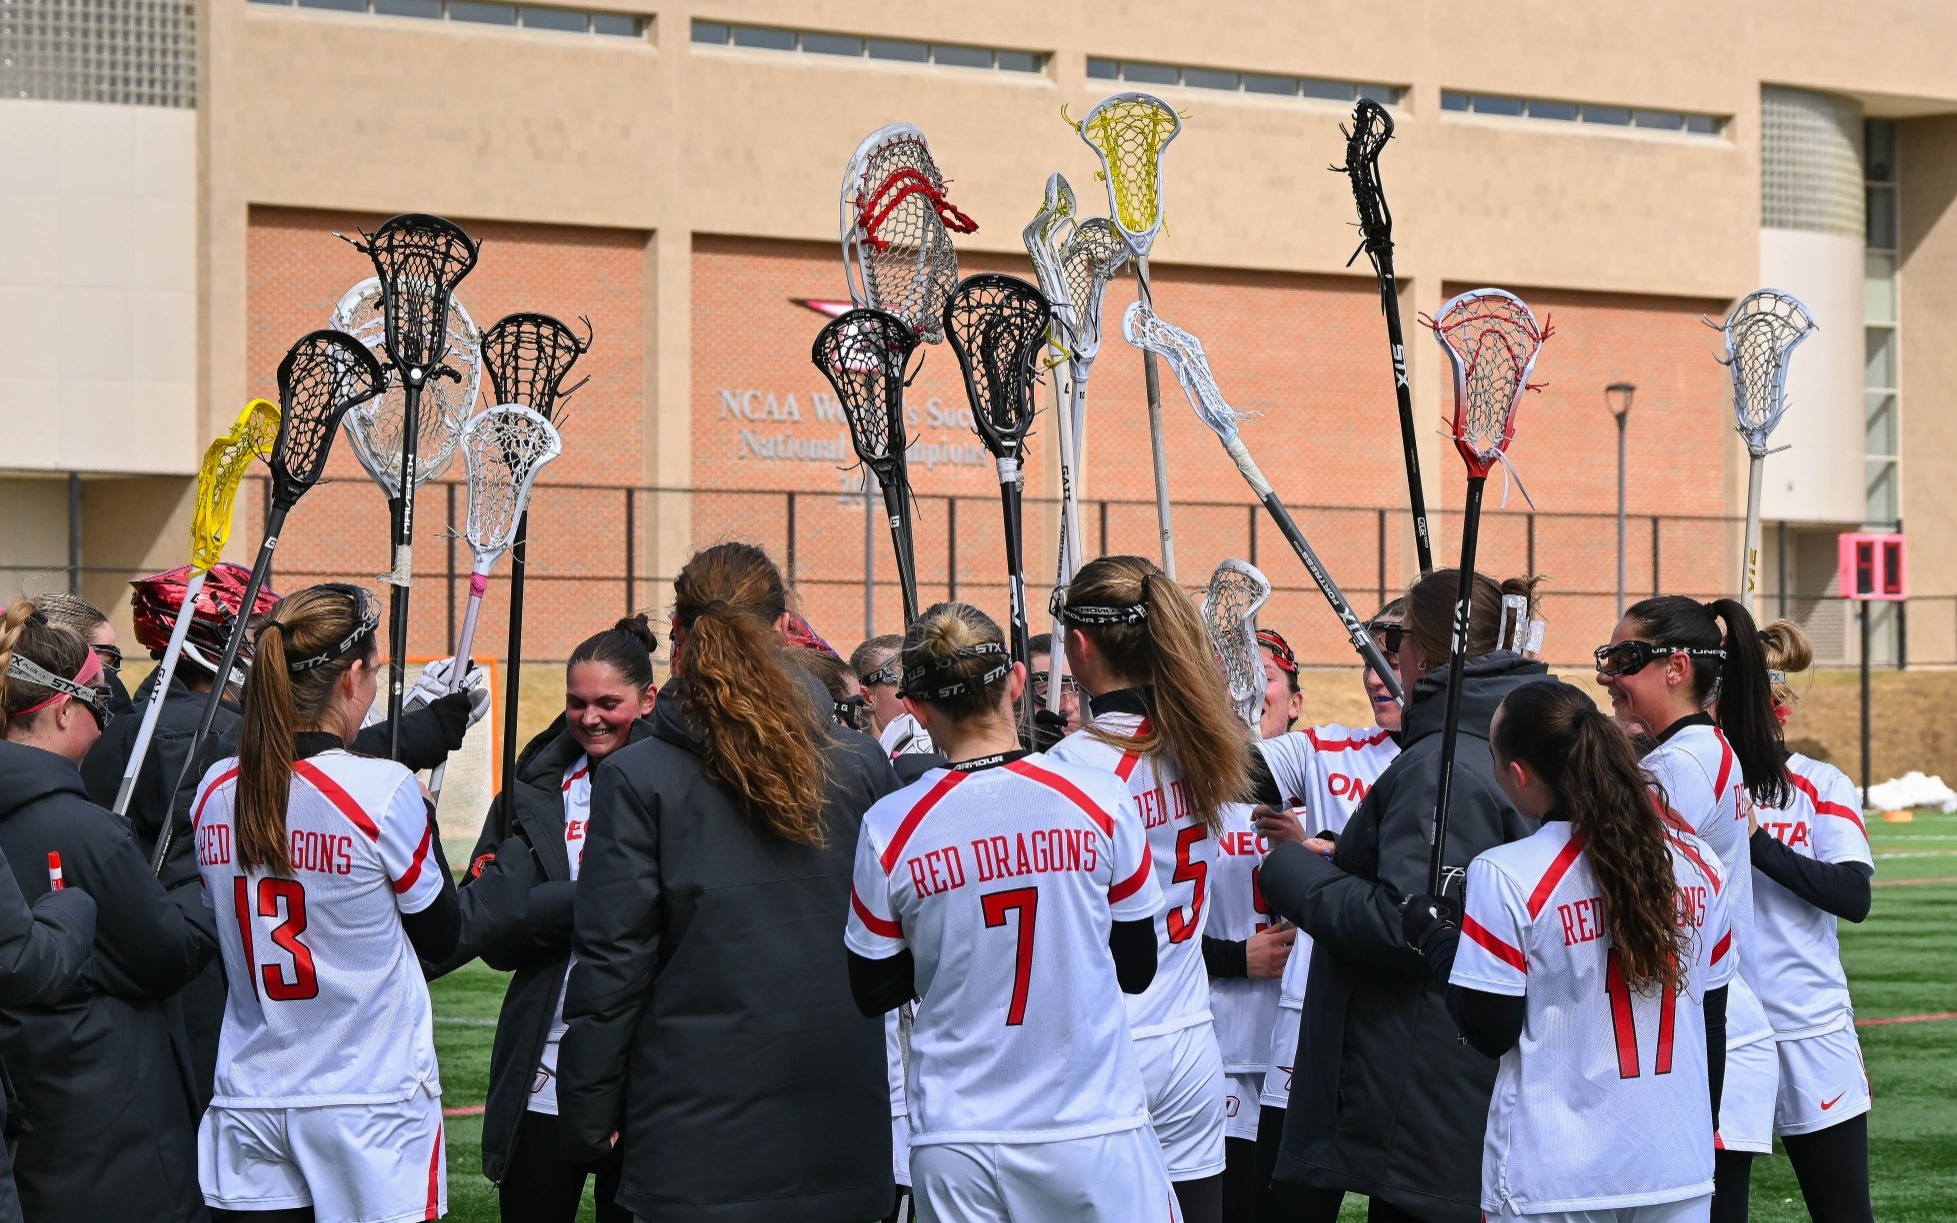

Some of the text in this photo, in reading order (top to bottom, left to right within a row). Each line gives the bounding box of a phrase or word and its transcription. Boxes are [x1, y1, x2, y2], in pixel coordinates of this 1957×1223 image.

[1392, 343, 1409, 389] STX
[719, 389, 800, 422] NCAA
[738, 429, 847, 462] National
[403, 453, 414, 535] MAVERIK
[1061, 465, 1071, 502] GAIT
[1301, 551, 1371, 646] STX FORTRESS
[292, 622, 368, 672] STX STX
[975, 642, 1002, 654] STX
[51, 678, 80, 696] STX
[150, 668, 166, 704] GAIT
[983, 664, 1007, 684] STX
[953, 755, 1004, 771] ARMOUR
[907, 828, 1097, 899] RED DRAGONS
[1167, 822, 1208, 944] 5
[233, 875, 320, 1002] 13
[1557, 896, 1607, 946] RED
[981, 886, 1039, 1026] 7
